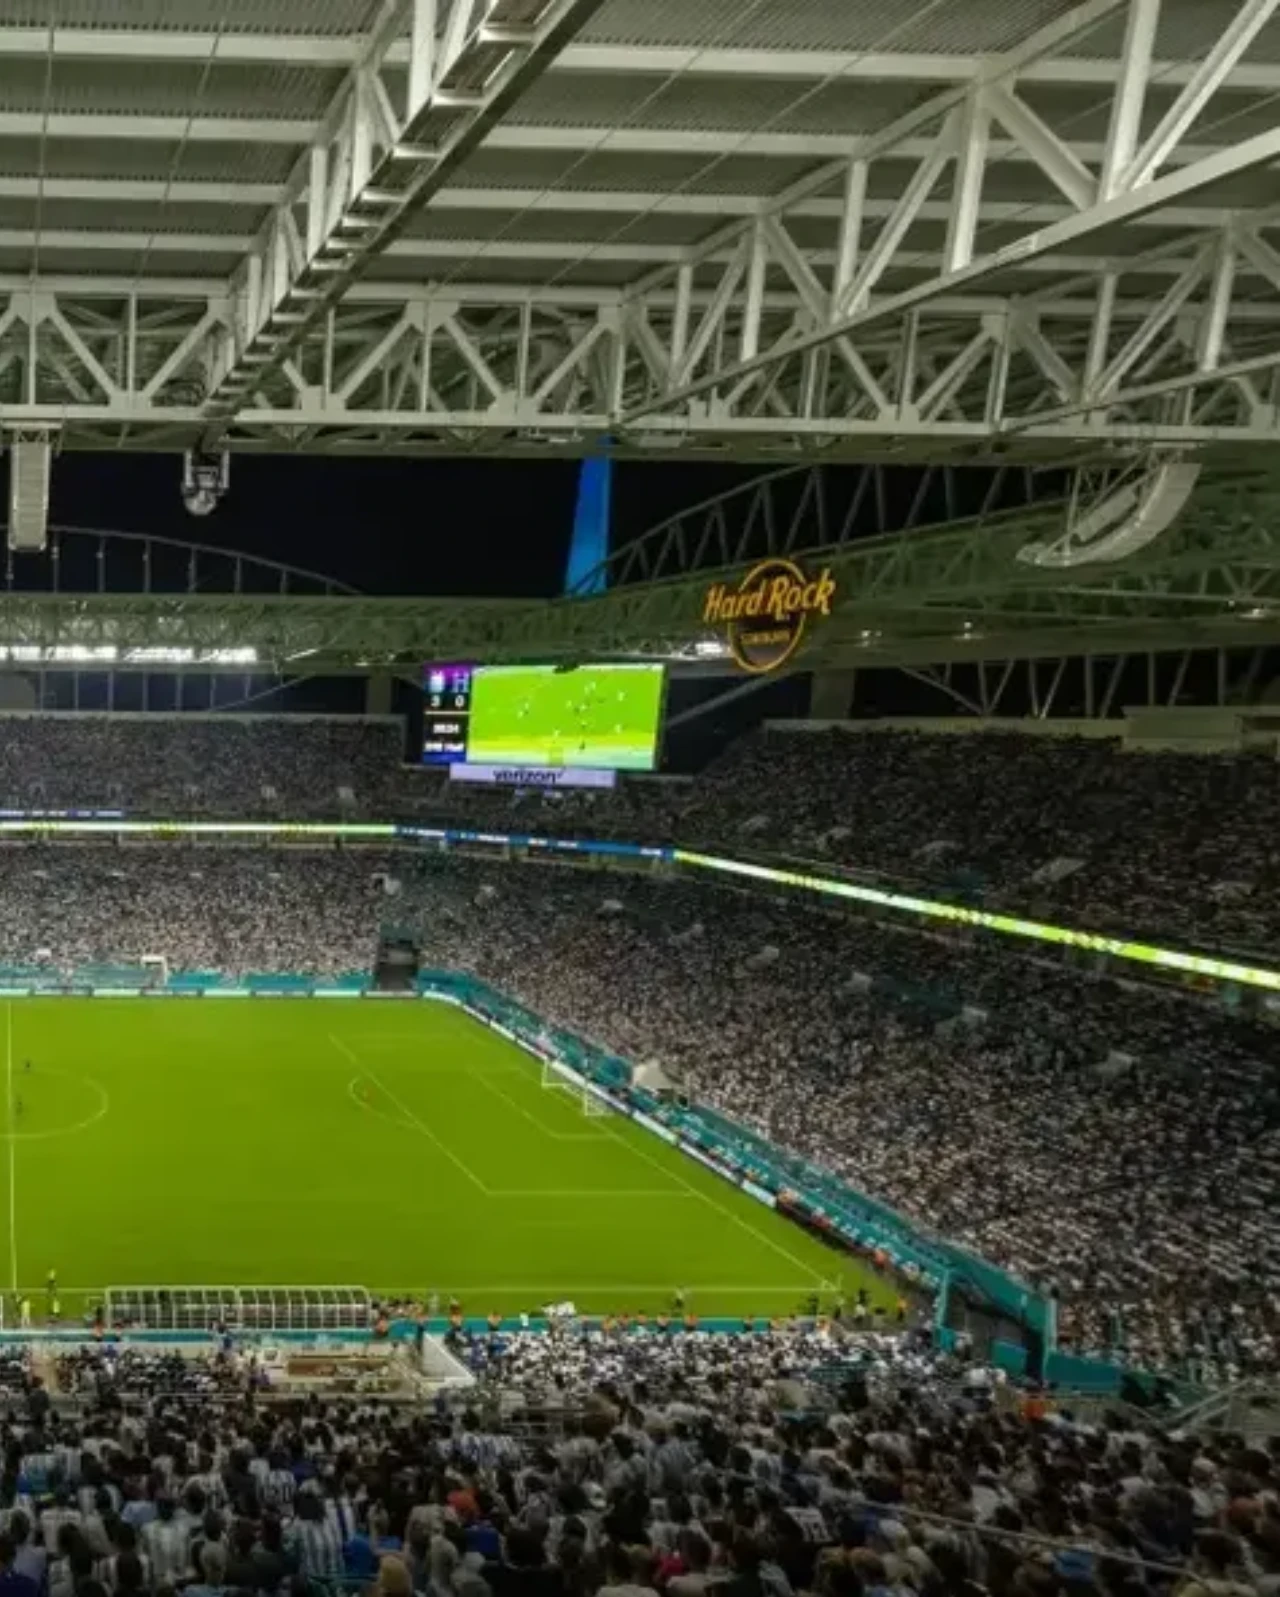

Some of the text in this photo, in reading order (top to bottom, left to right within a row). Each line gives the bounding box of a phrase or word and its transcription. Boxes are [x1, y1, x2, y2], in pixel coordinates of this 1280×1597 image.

[703, 568, 836, 623] Hard Rock
[494, 767, 557, 784] verizon
